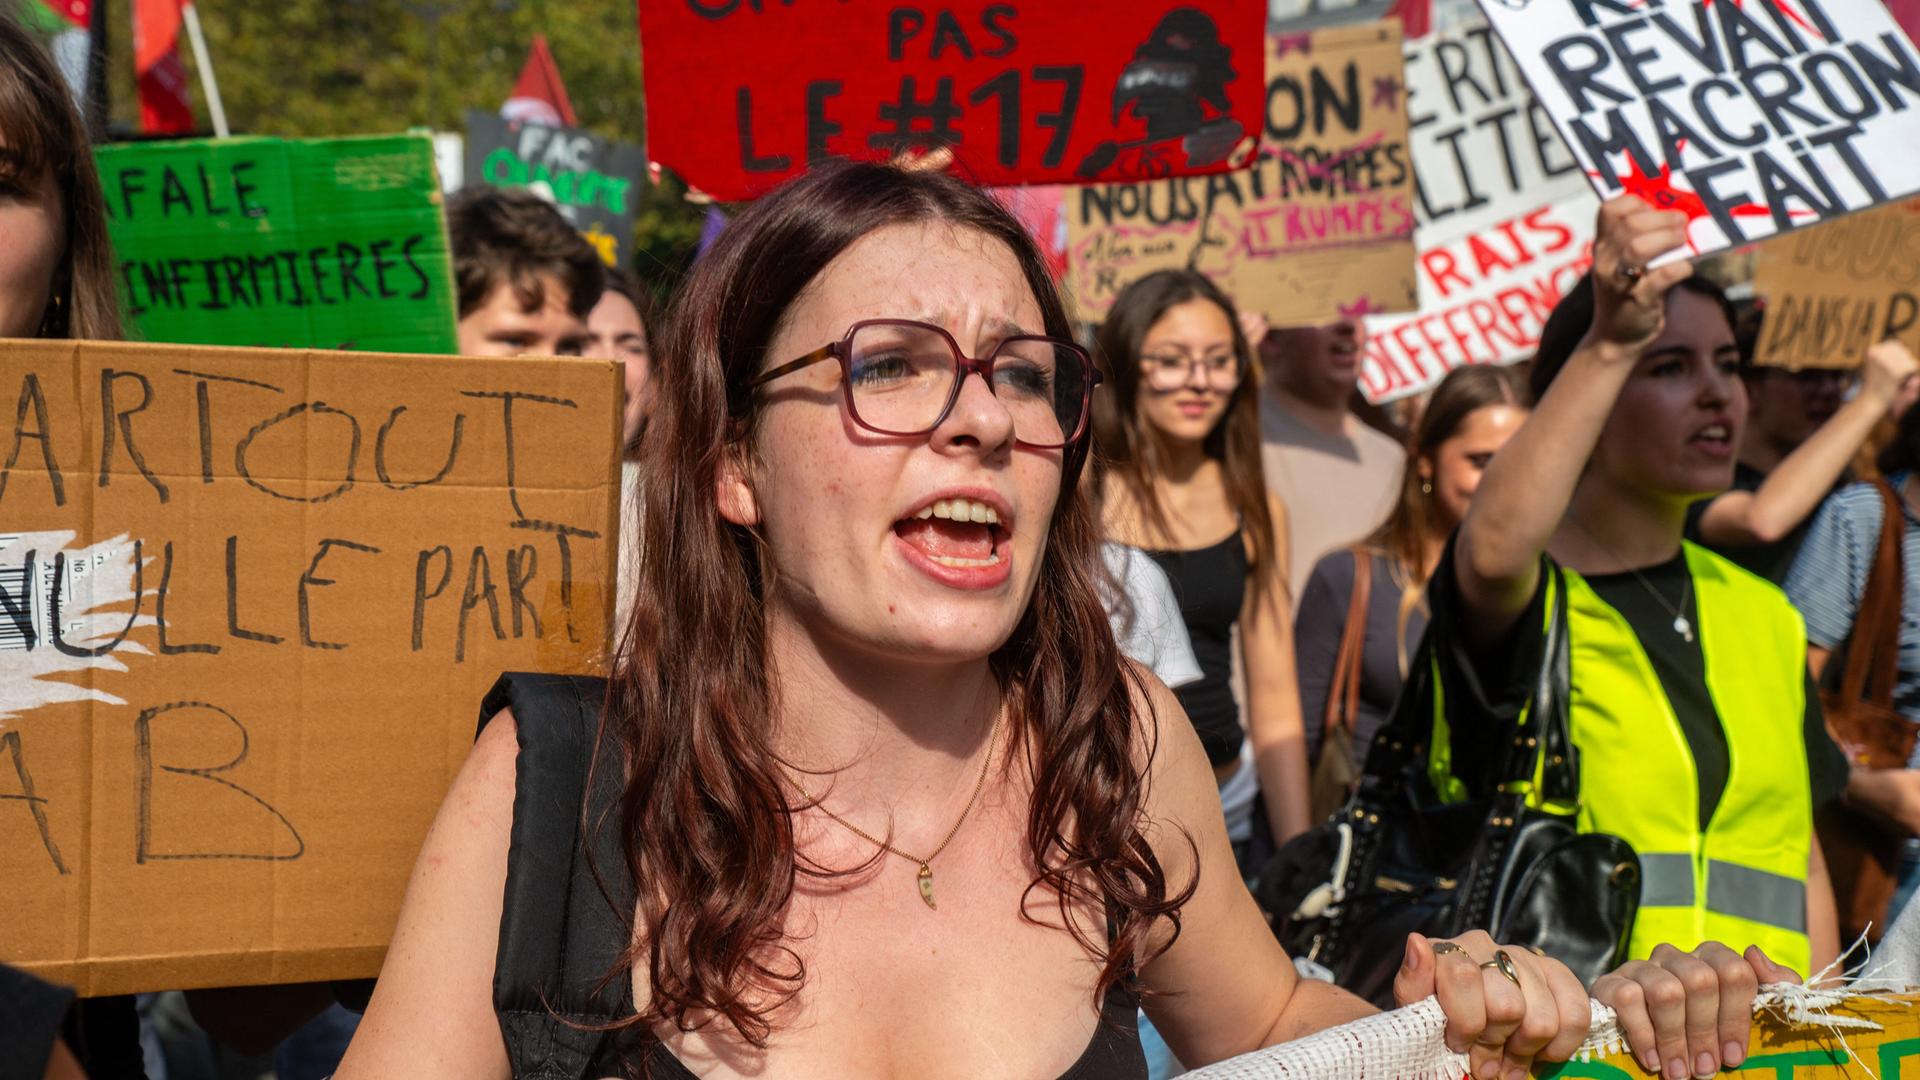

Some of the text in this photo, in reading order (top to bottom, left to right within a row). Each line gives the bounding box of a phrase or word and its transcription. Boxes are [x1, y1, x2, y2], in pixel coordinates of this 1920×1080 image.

[889, 8, 1019, 61] PAS
[736, 64, 1086, 173] LE #17
[1265, 62, 1362, 140] ON
[1567, 32, 1920, 191] MACRON
[95, 162, 271, 218] FALE
[518, 126, 594, 173] FAC
[1413, 101, 1578, 222] LITE
[1081, 178, 1198, 226] NOUS
[121, 233, 430, 317] INFIRMIERES
[1419, 205, 1573, 298] RAIS
[1356, 241, 1594, 400] DIFFERENC
[0, 368, 579, 518] ARTOUT
[0, 535, 383, 658] NULLE
[409, 520, 601, 663] PART
